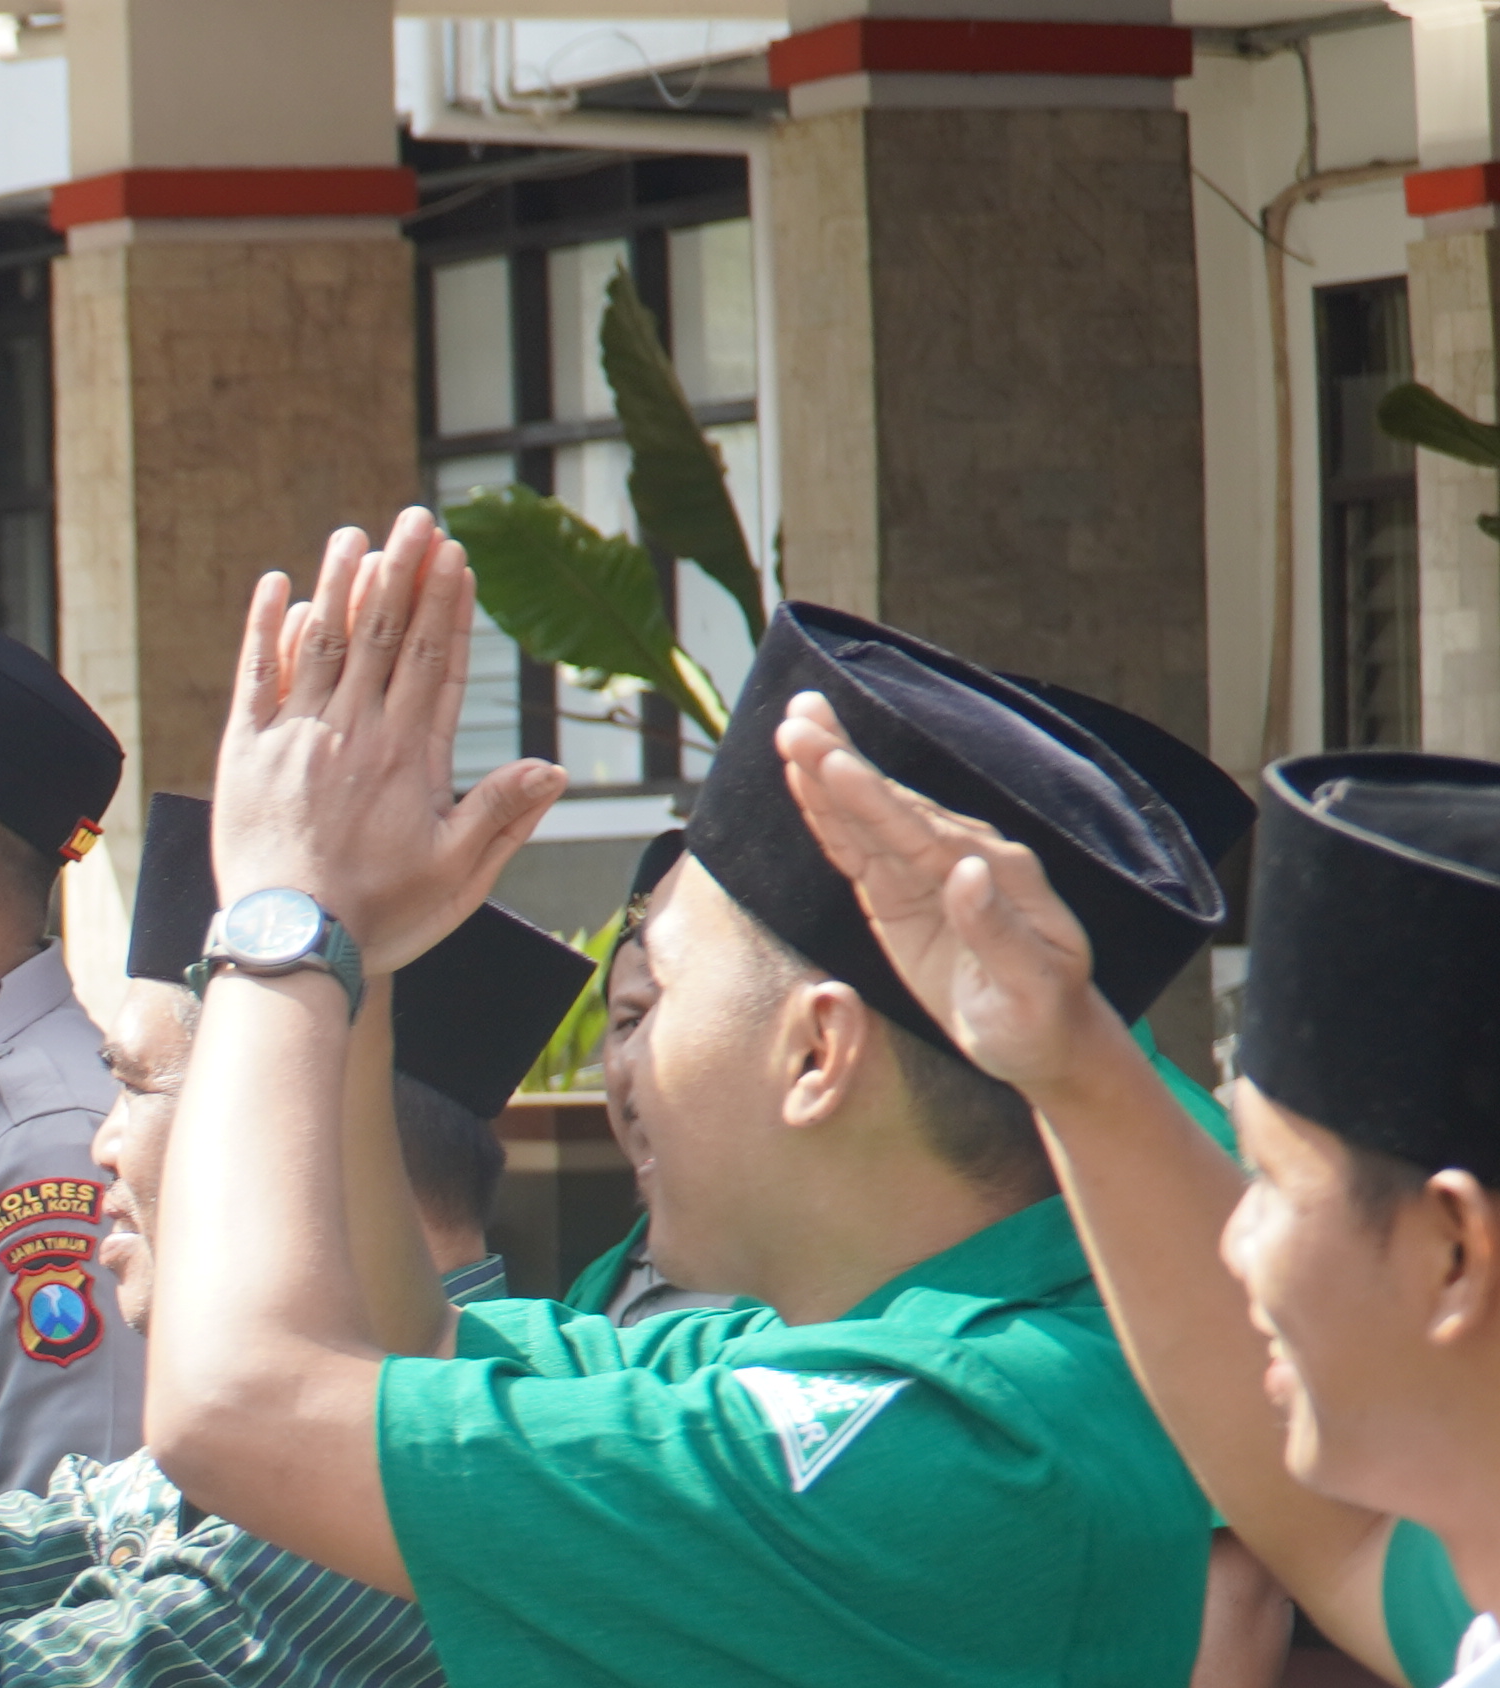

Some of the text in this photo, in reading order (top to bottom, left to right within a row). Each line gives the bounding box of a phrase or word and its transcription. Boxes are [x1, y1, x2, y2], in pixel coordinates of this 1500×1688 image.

[47, 1199, 90, 1214] KOTA
[10, 1237, 87, 1263] JAWA TIMUR
